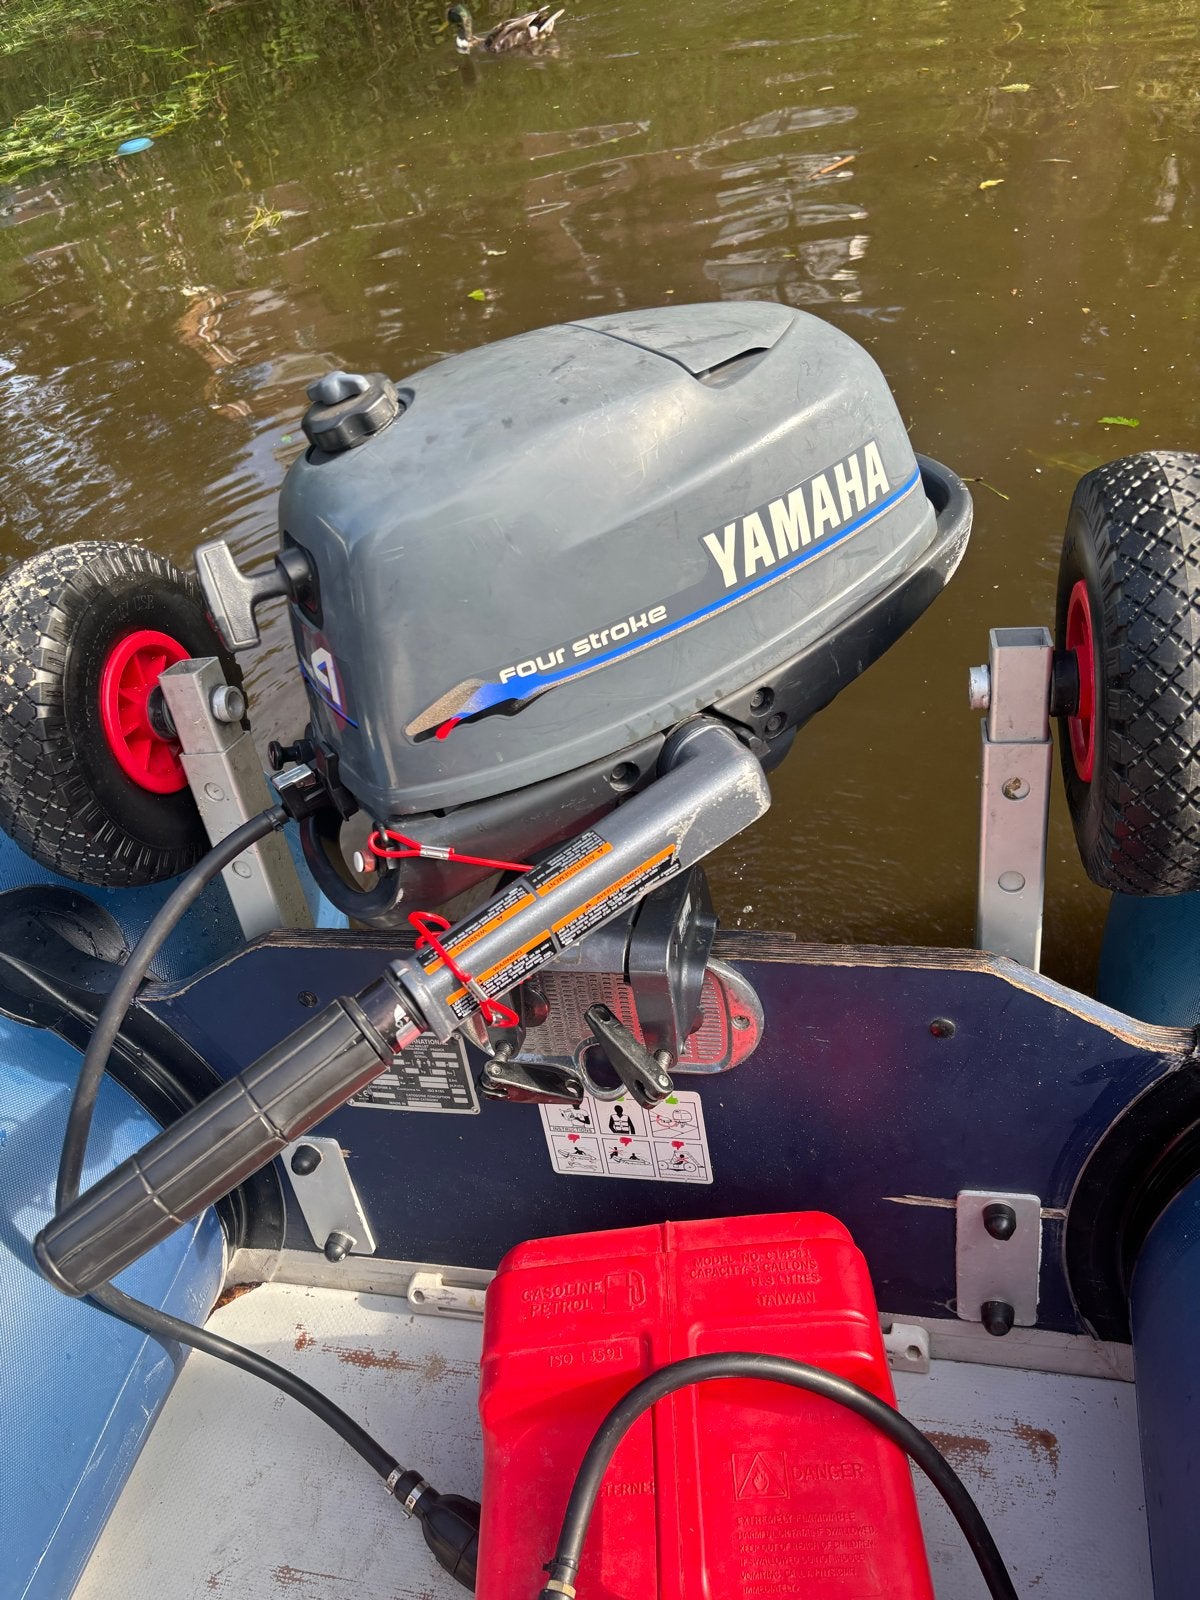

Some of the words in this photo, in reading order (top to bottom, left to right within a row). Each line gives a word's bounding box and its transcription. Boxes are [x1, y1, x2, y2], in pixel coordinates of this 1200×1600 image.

[703, 440, 891, 588] YAMAHA
[693, 1254, 735, 1268] MODEL
[762, 1259, 818, 1273] GALLONS
[521, 1280, 604, 1302] GASOLINE
[757, 1291, 817, 1307] TAIWAN
[530, 1299, 594, 1319] PETROL
[549, 1352, 574, 1368] ISO
[791, 1462, 865, 1482] DANGER
